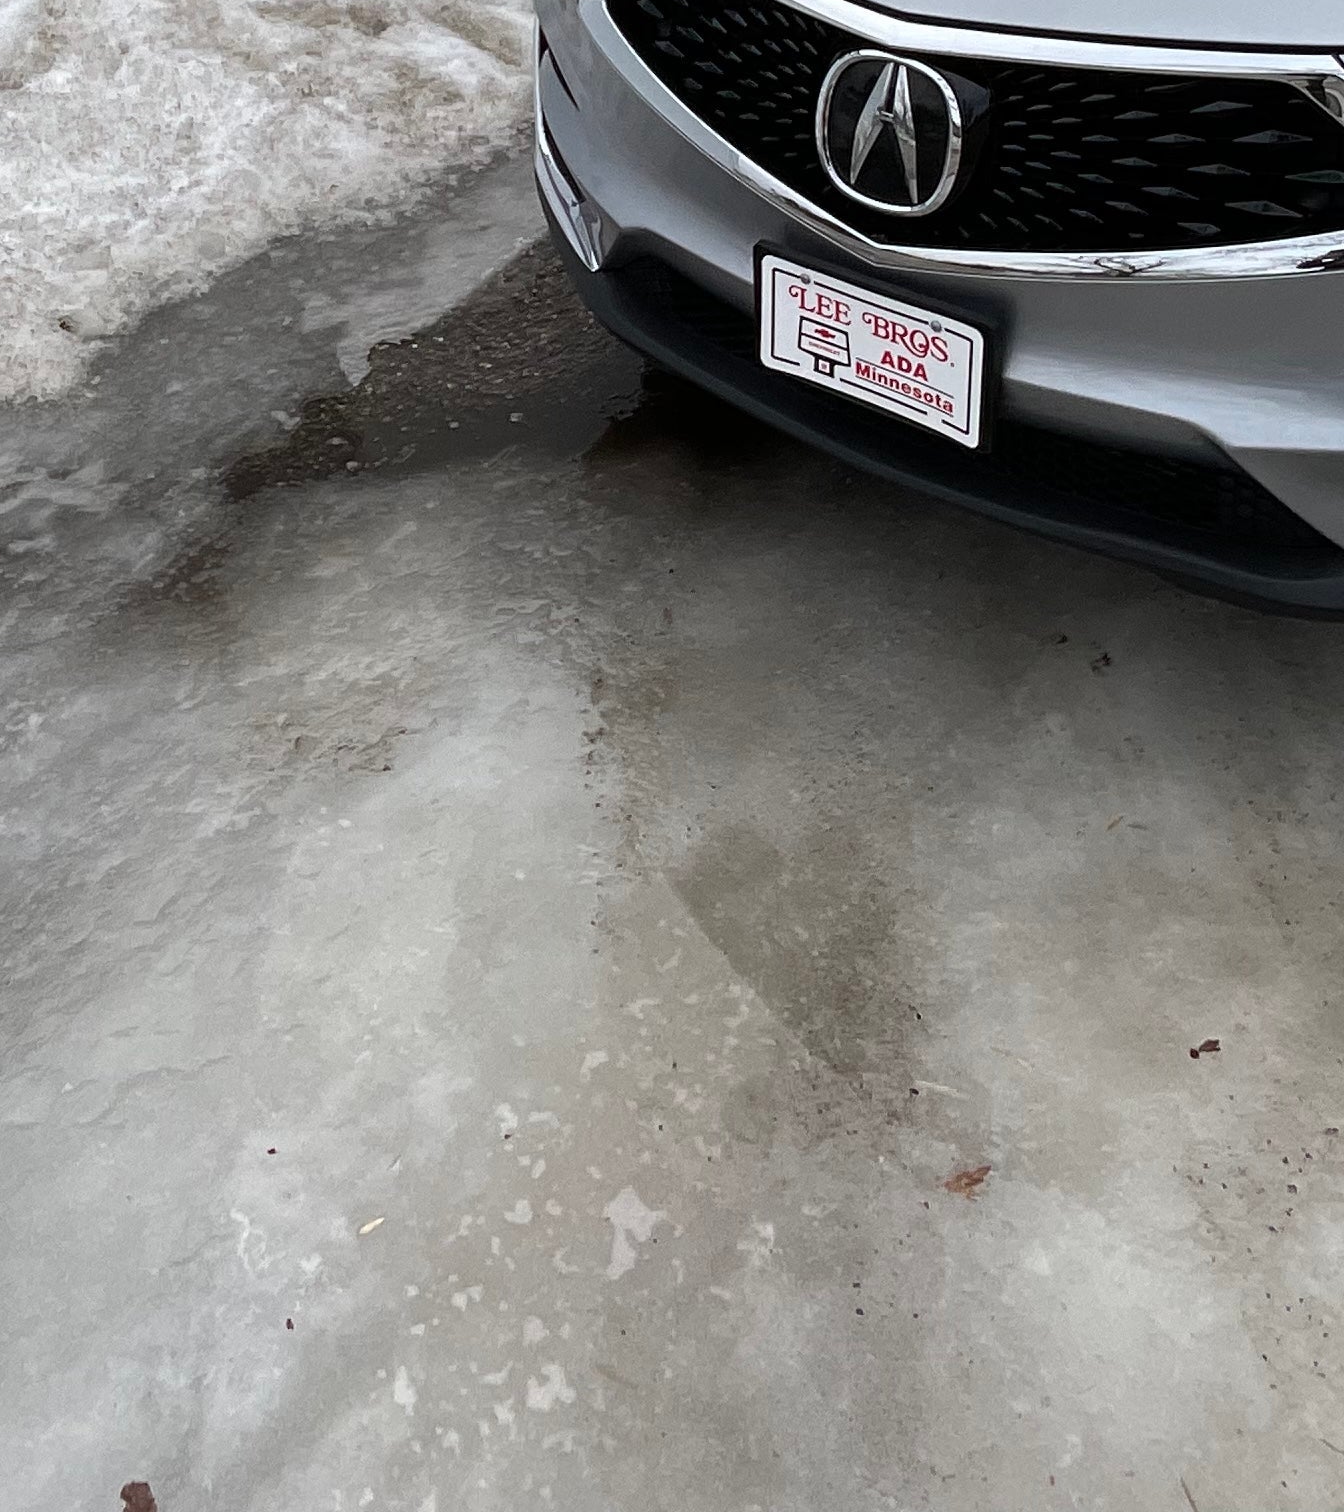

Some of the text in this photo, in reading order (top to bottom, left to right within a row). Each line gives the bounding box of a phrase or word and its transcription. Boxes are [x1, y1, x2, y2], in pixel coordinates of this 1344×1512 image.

[788, 284, 852, 326] LEE
[880, 350, 928, 382] ADA
[855, 361, 954, 414] Minnesota
